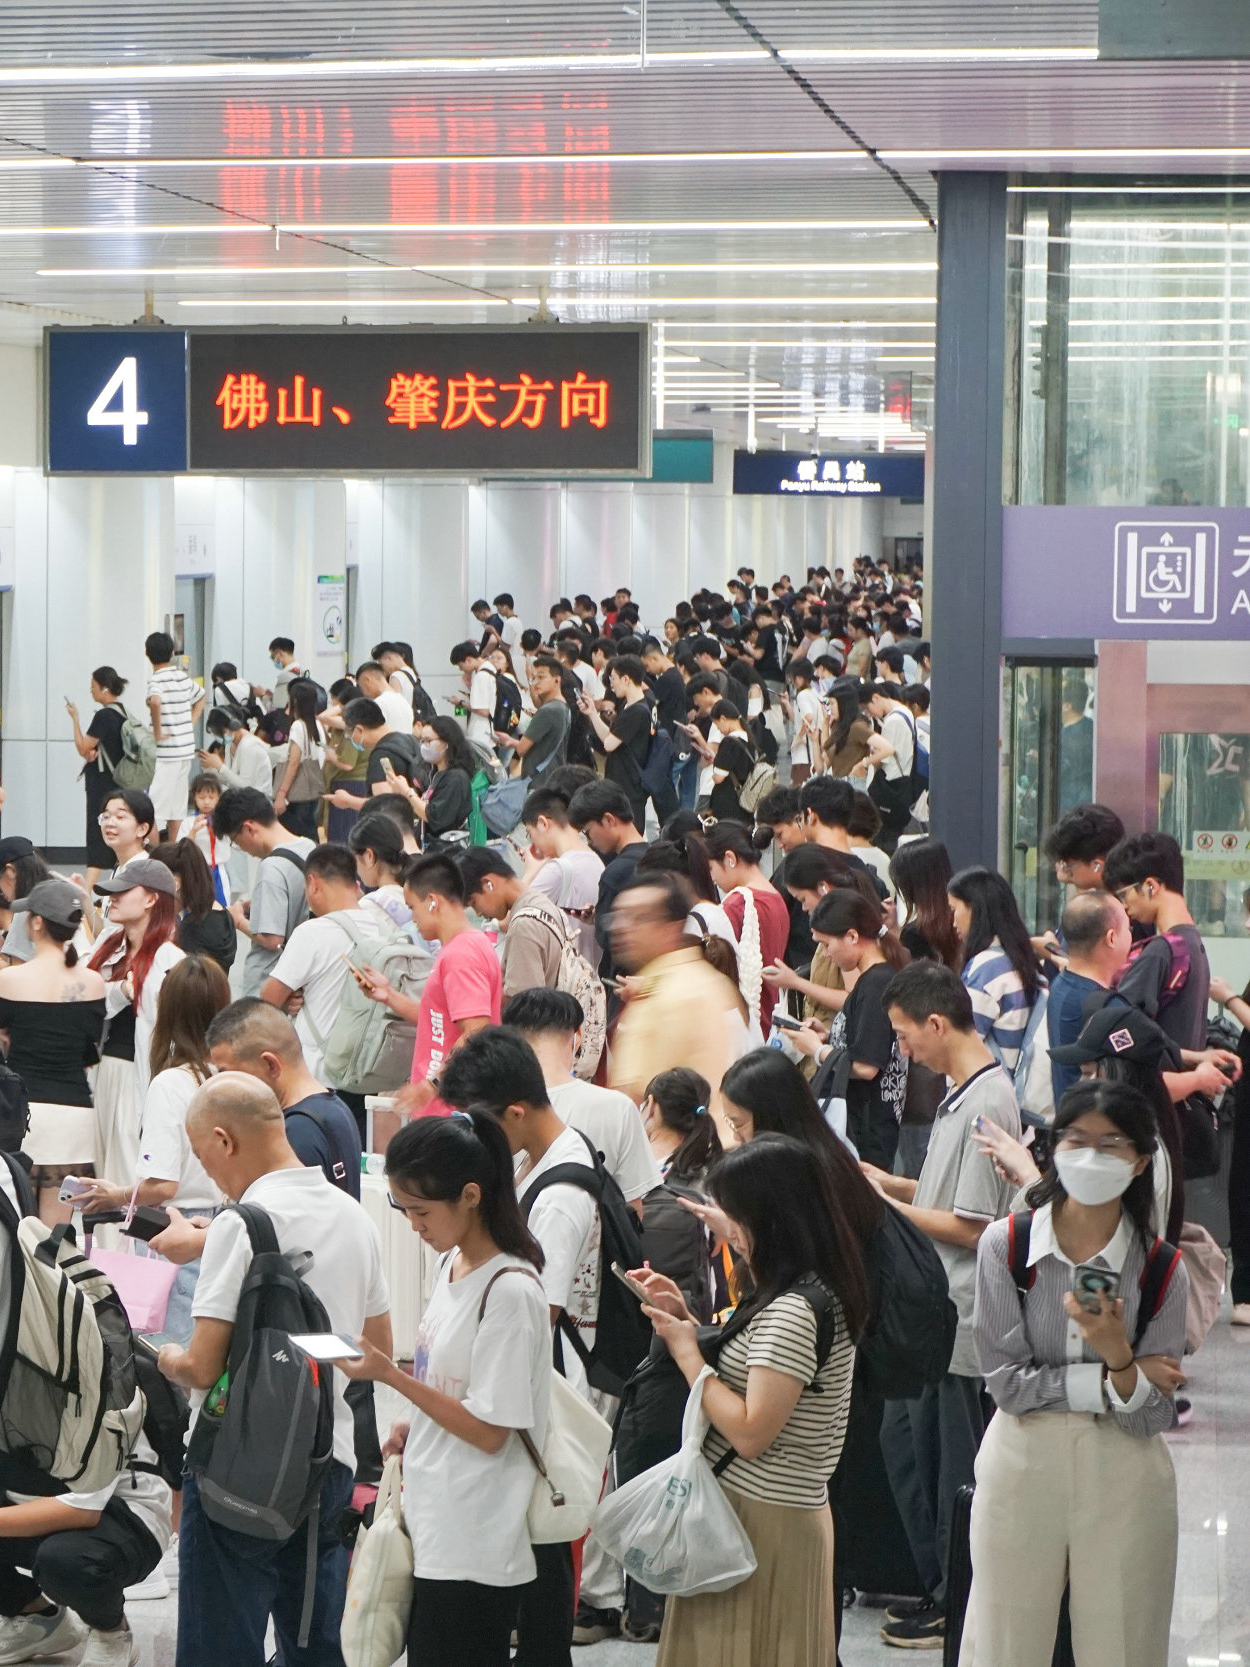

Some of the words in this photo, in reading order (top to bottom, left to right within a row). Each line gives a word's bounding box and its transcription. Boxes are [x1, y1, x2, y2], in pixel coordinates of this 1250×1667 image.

[87, 356, 149, 446] 4
[215, 372, 609, 430] 佛山、肇庆方向
[429, 1008, 445, 1047] JUST
